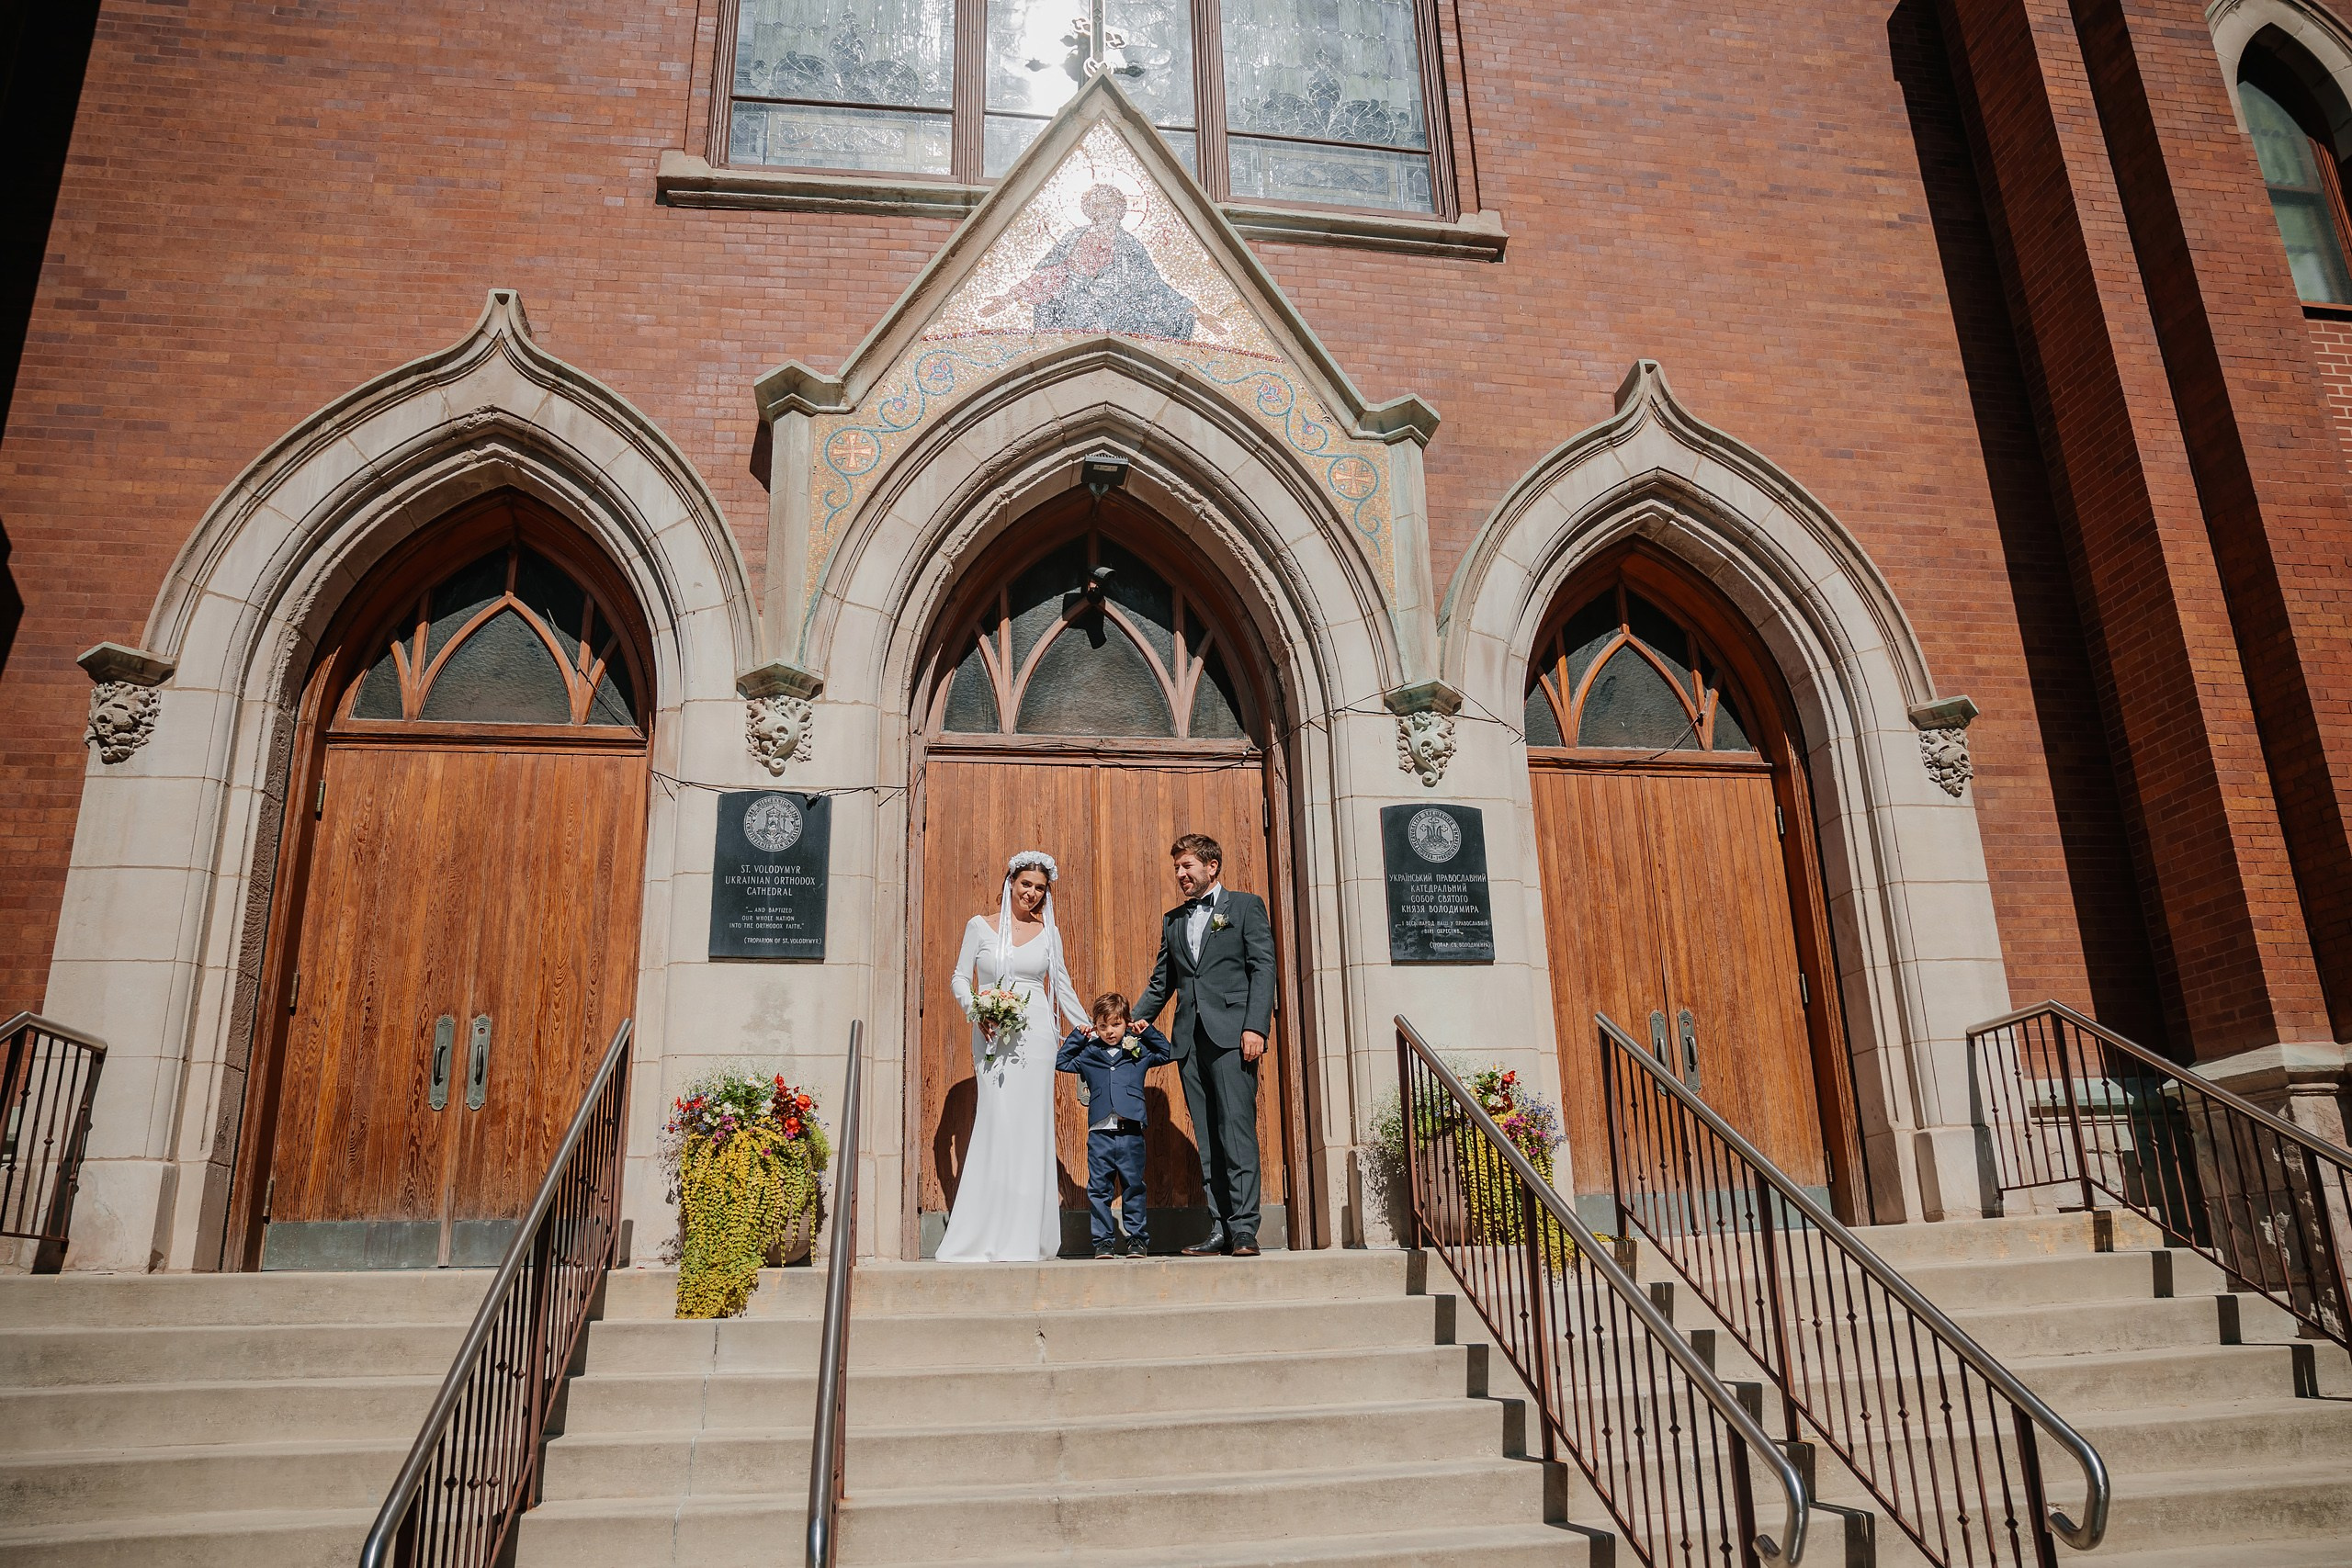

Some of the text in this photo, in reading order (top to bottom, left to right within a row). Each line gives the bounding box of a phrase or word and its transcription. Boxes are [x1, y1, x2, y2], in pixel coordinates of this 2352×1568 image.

[754, 865, 801, 874] VOLODYMYR
[774, 877, 815, 885] ORTHODOX
[1389, 873, 1487, 882] УКРАЇНСЬКИЙ ПРАВОСЛАВНИЙ
[746, 887, 792, 896] CATHEDRAL
[1411, 883, 1467, 893] КАТЕДРАЛЬНИЙ
[1411, 895, 1468, 903] СОБОР СВЯТОГО
[1402, 905, 1479, 914] КНЯЗЯ ВОЛОДИМИРА
